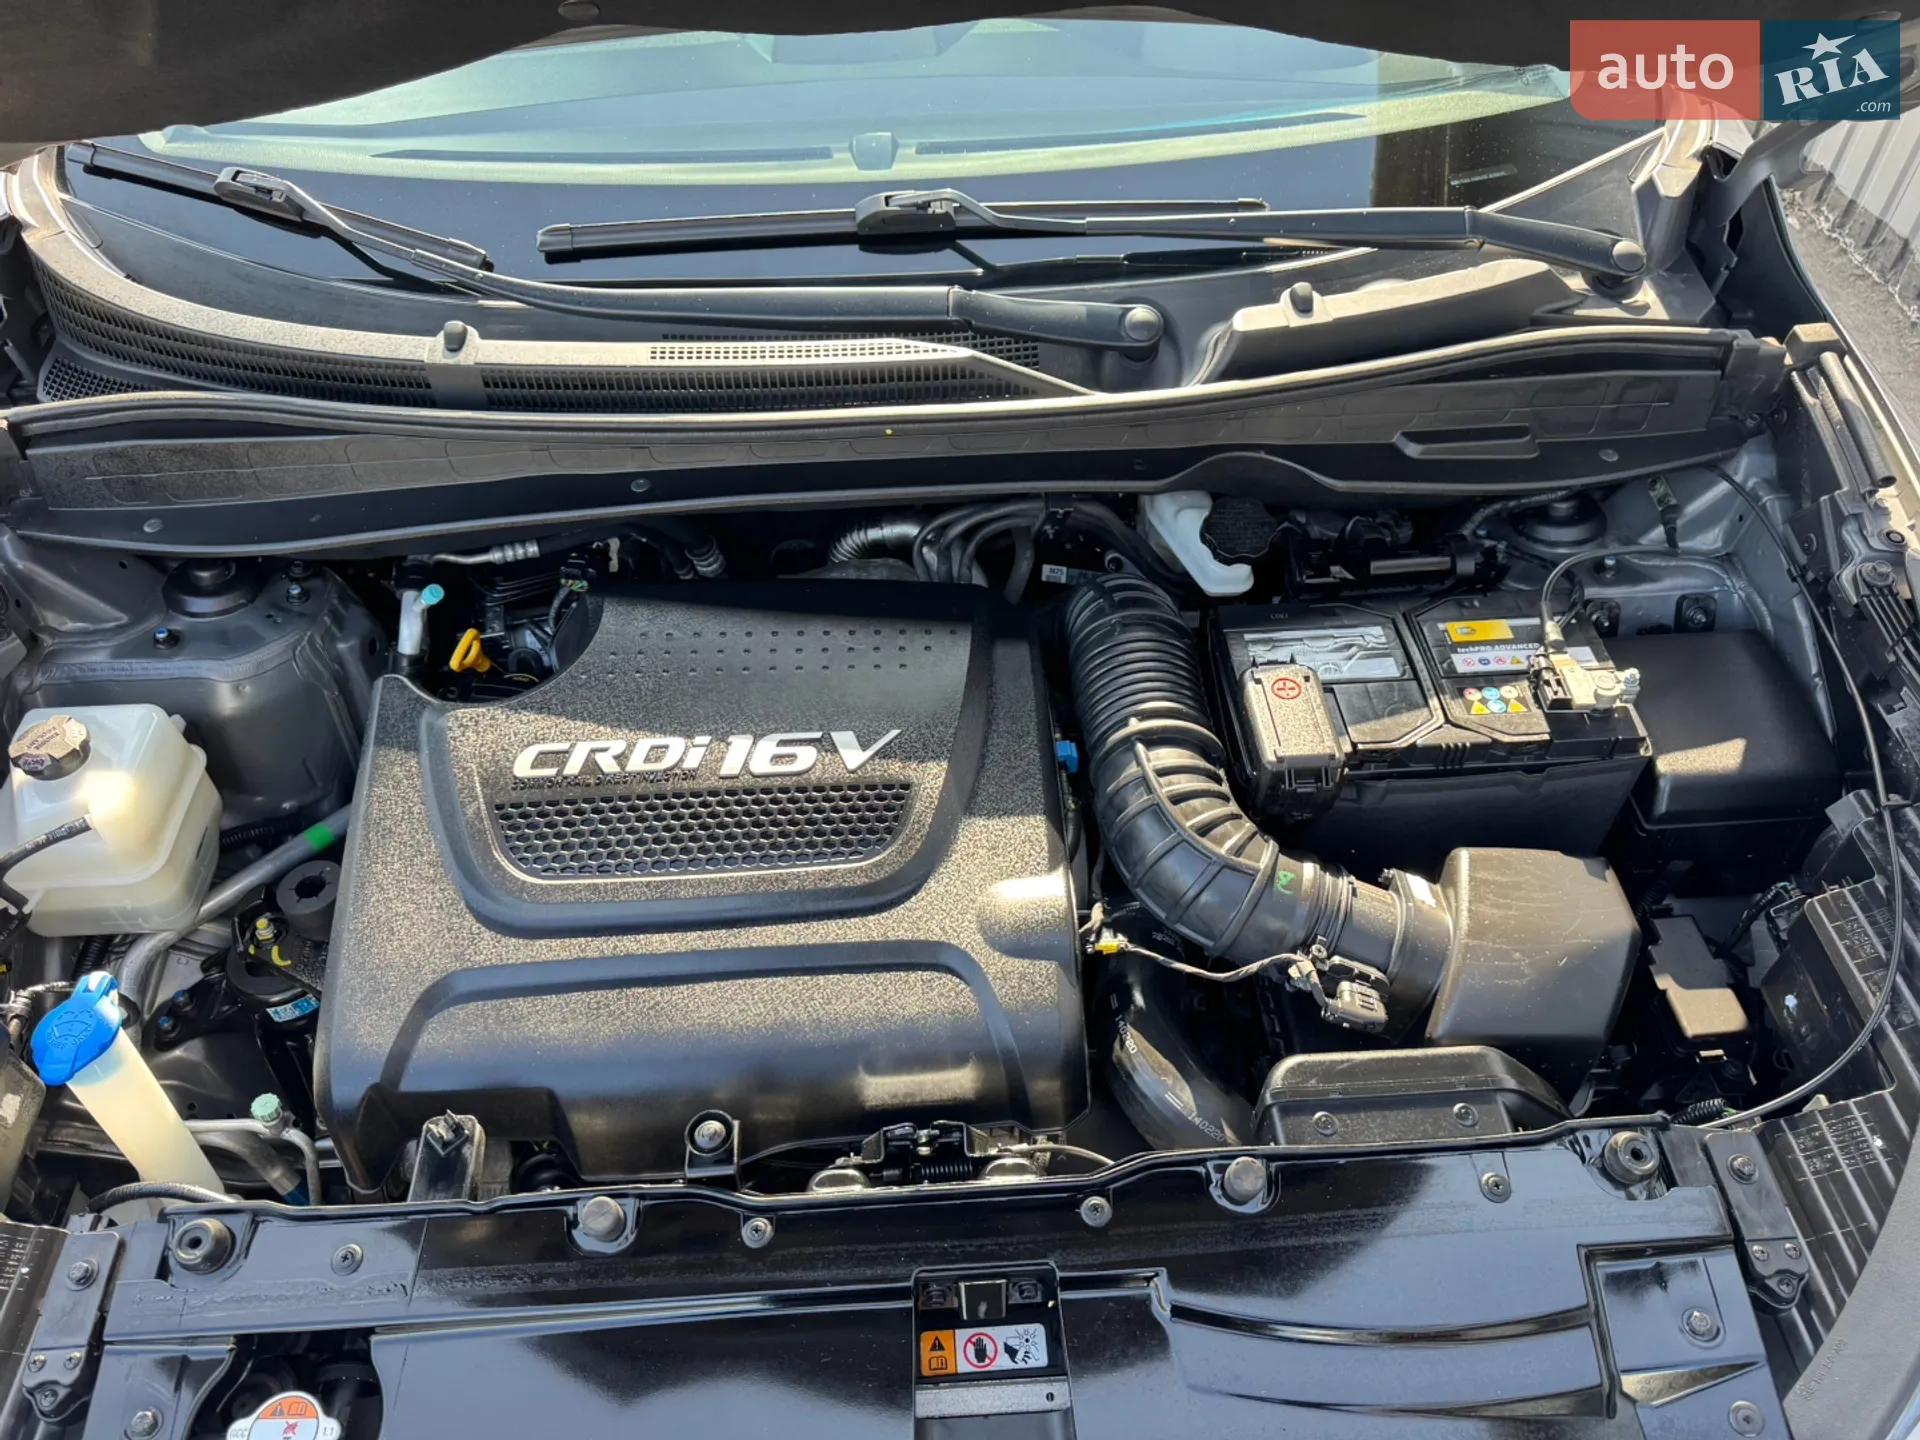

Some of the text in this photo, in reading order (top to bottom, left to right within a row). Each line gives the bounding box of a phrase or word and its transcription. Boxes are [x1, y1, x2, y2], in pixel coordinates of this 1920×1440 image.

[1494, 642, 1540, 650] ADVANCED
[513, 729, 901, 779] CRDi 16V
[510, 776, 562, 791] COMMON
[1188, 1111, 1225, 1141] 140220
